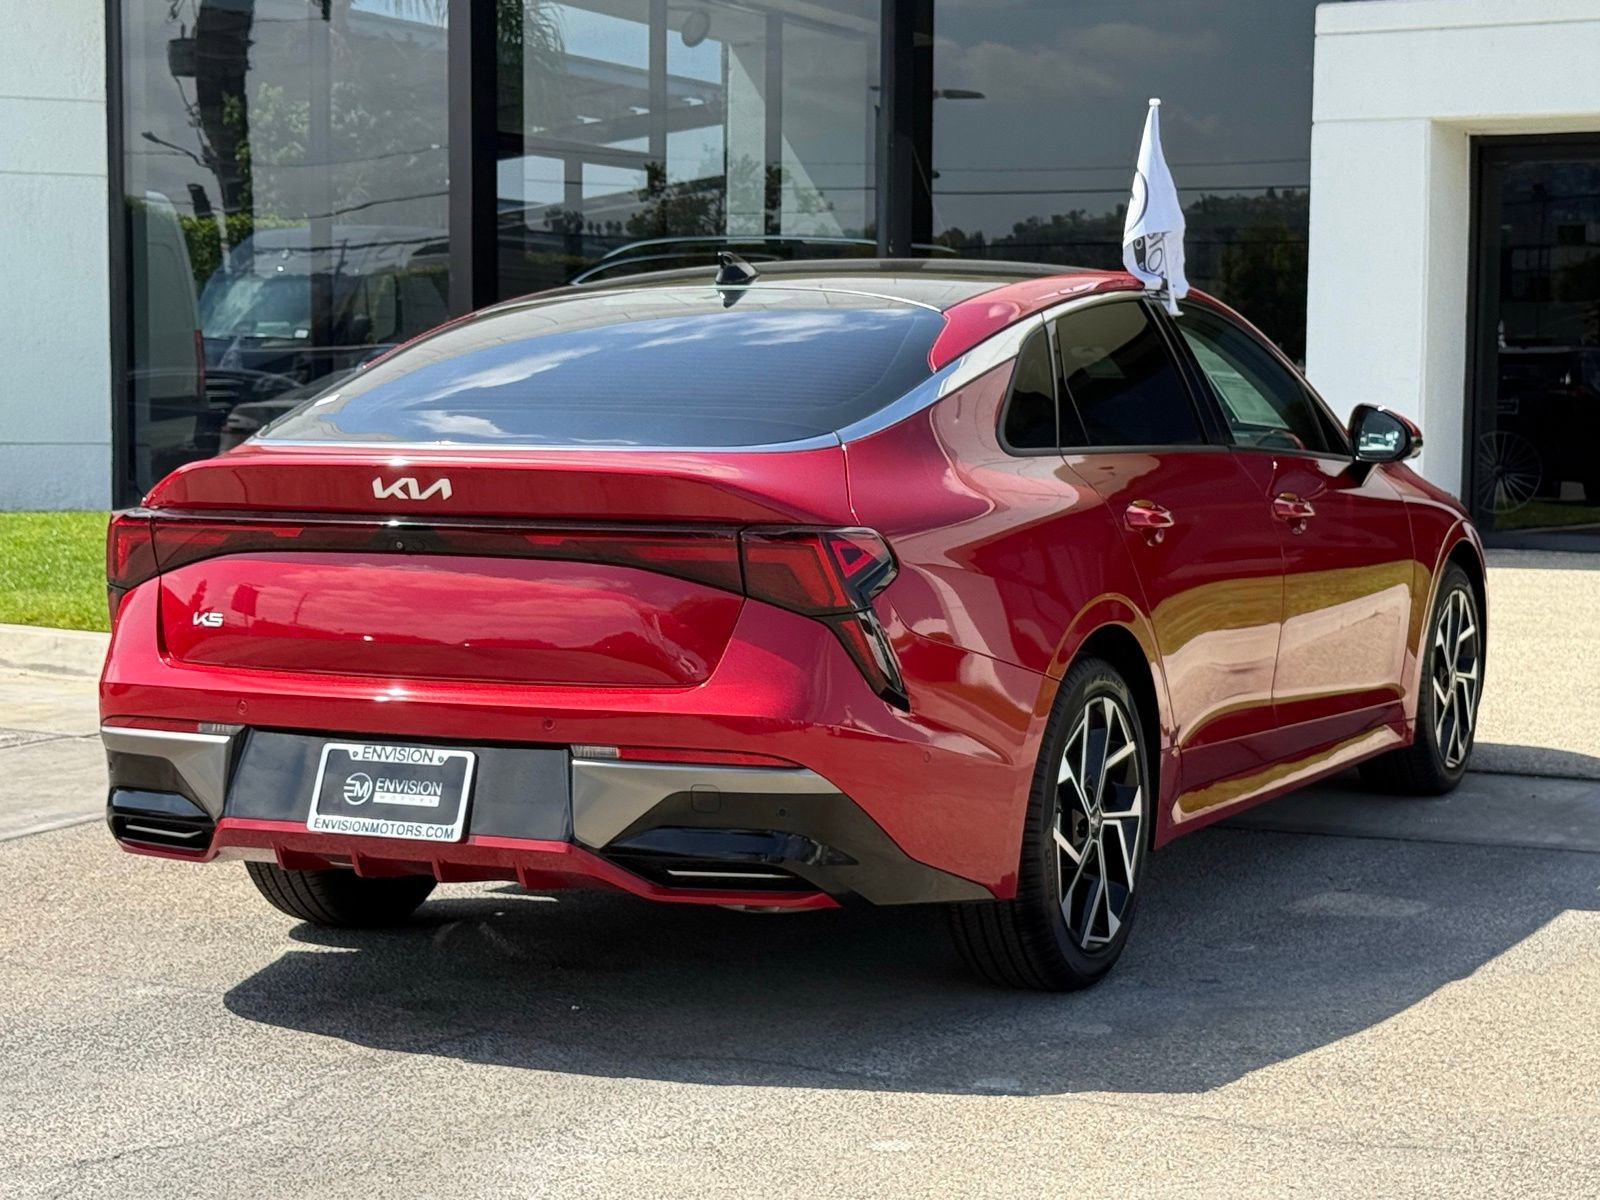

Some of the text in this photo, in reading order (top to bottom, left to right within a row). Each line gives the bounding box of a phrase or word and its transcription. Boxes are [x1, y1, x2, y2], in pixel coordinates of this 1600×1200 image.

[372, 477, 453, 500] KIA
[192, 611, 224, 628] K5
[362, 746, 435, 763] ENVISION
[375, 777, 443, 796] ENVISION
[313, 817, 454, 839] ENVISIONMOTORS.COM
